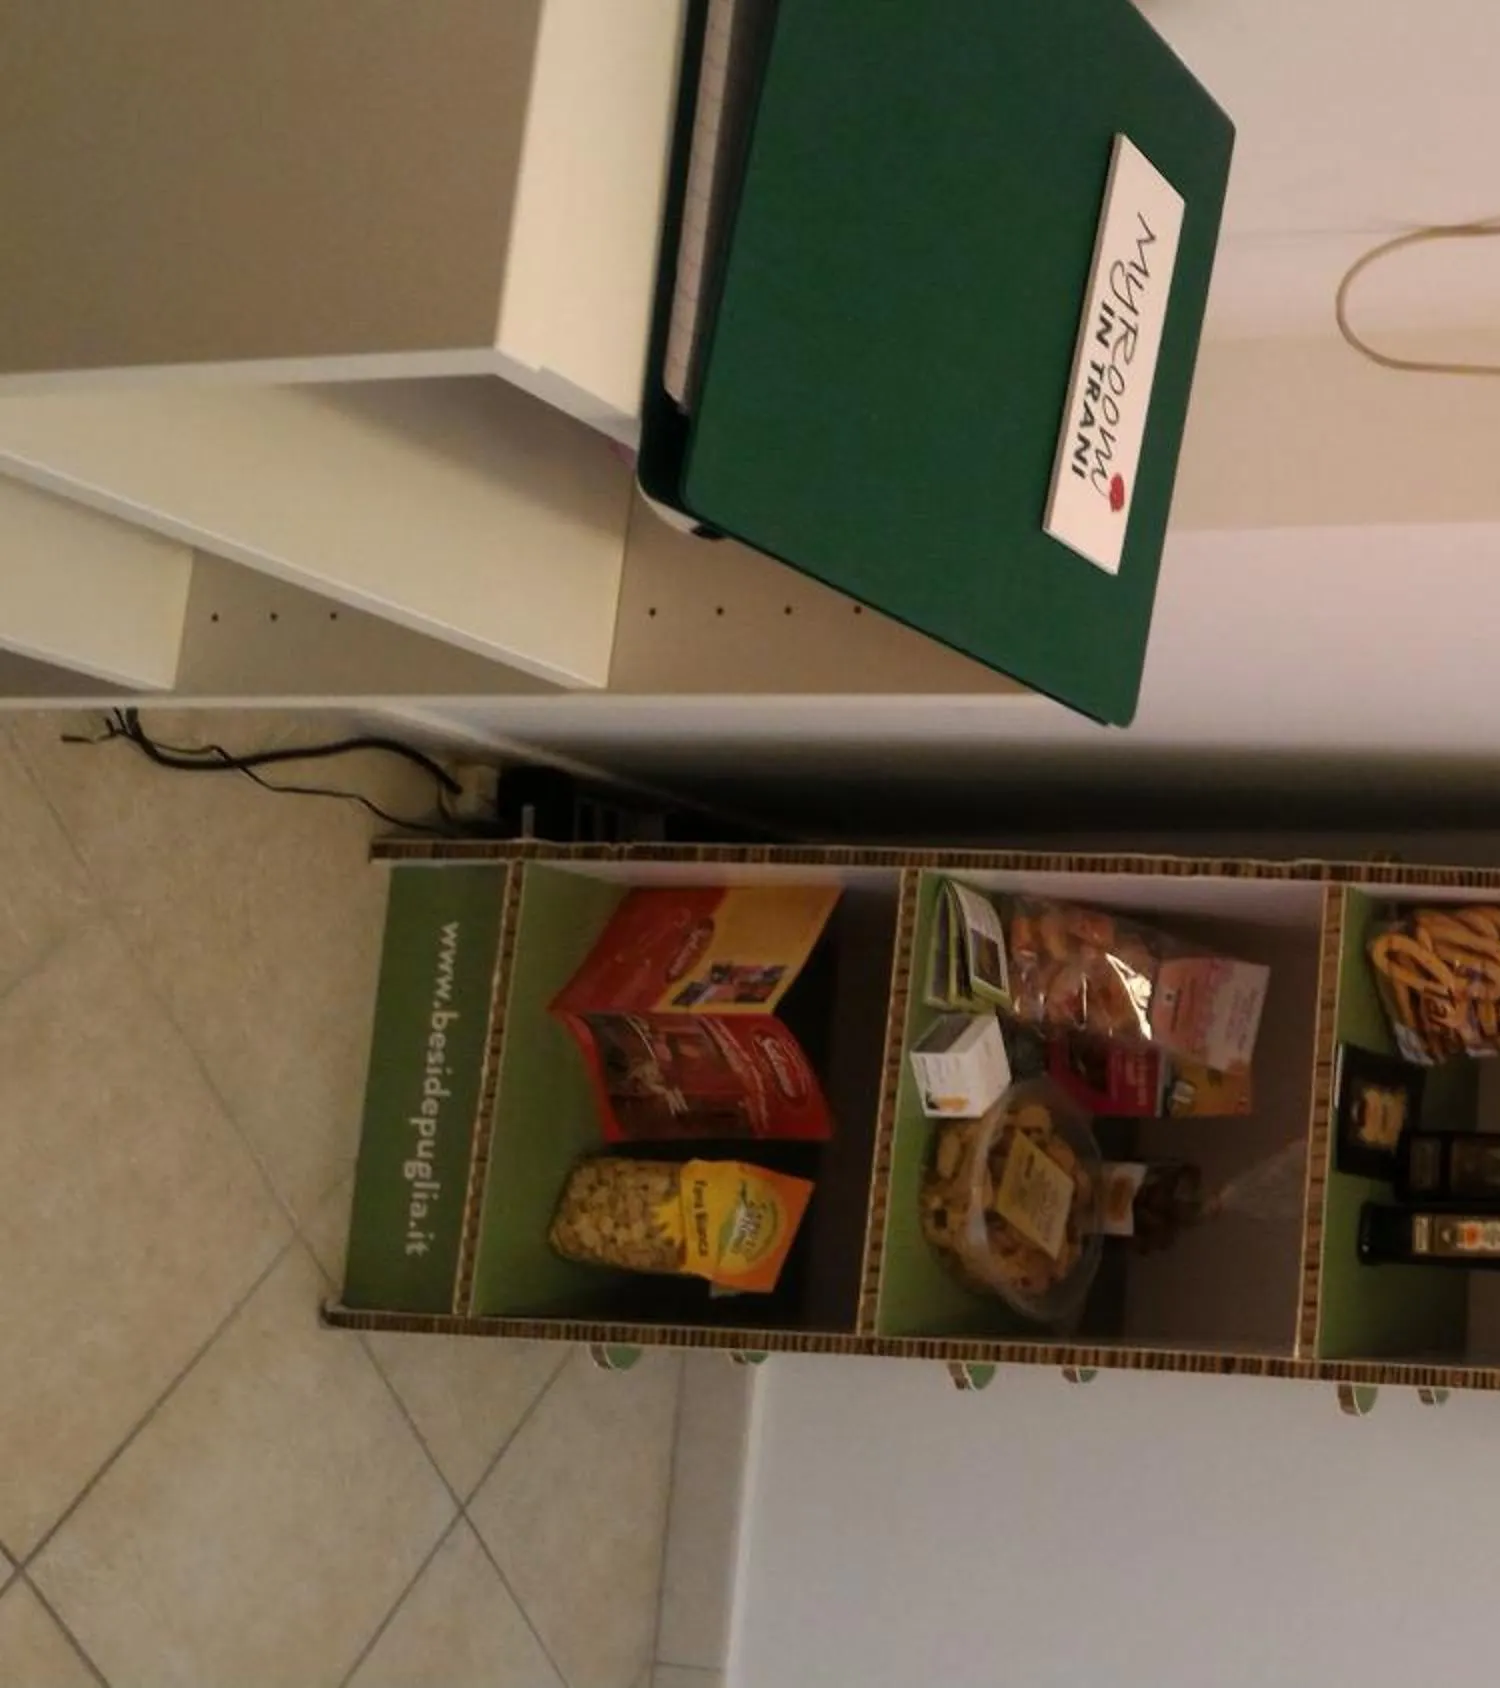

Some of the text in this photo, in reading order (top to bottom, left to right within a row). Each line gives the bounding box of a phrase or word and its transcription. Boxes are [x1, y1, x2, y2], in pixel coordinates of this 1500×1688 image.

[1071, 302, 1116, 480] IN TRANI
[404, 922, 459, 1256] www.besidepuglia.it
